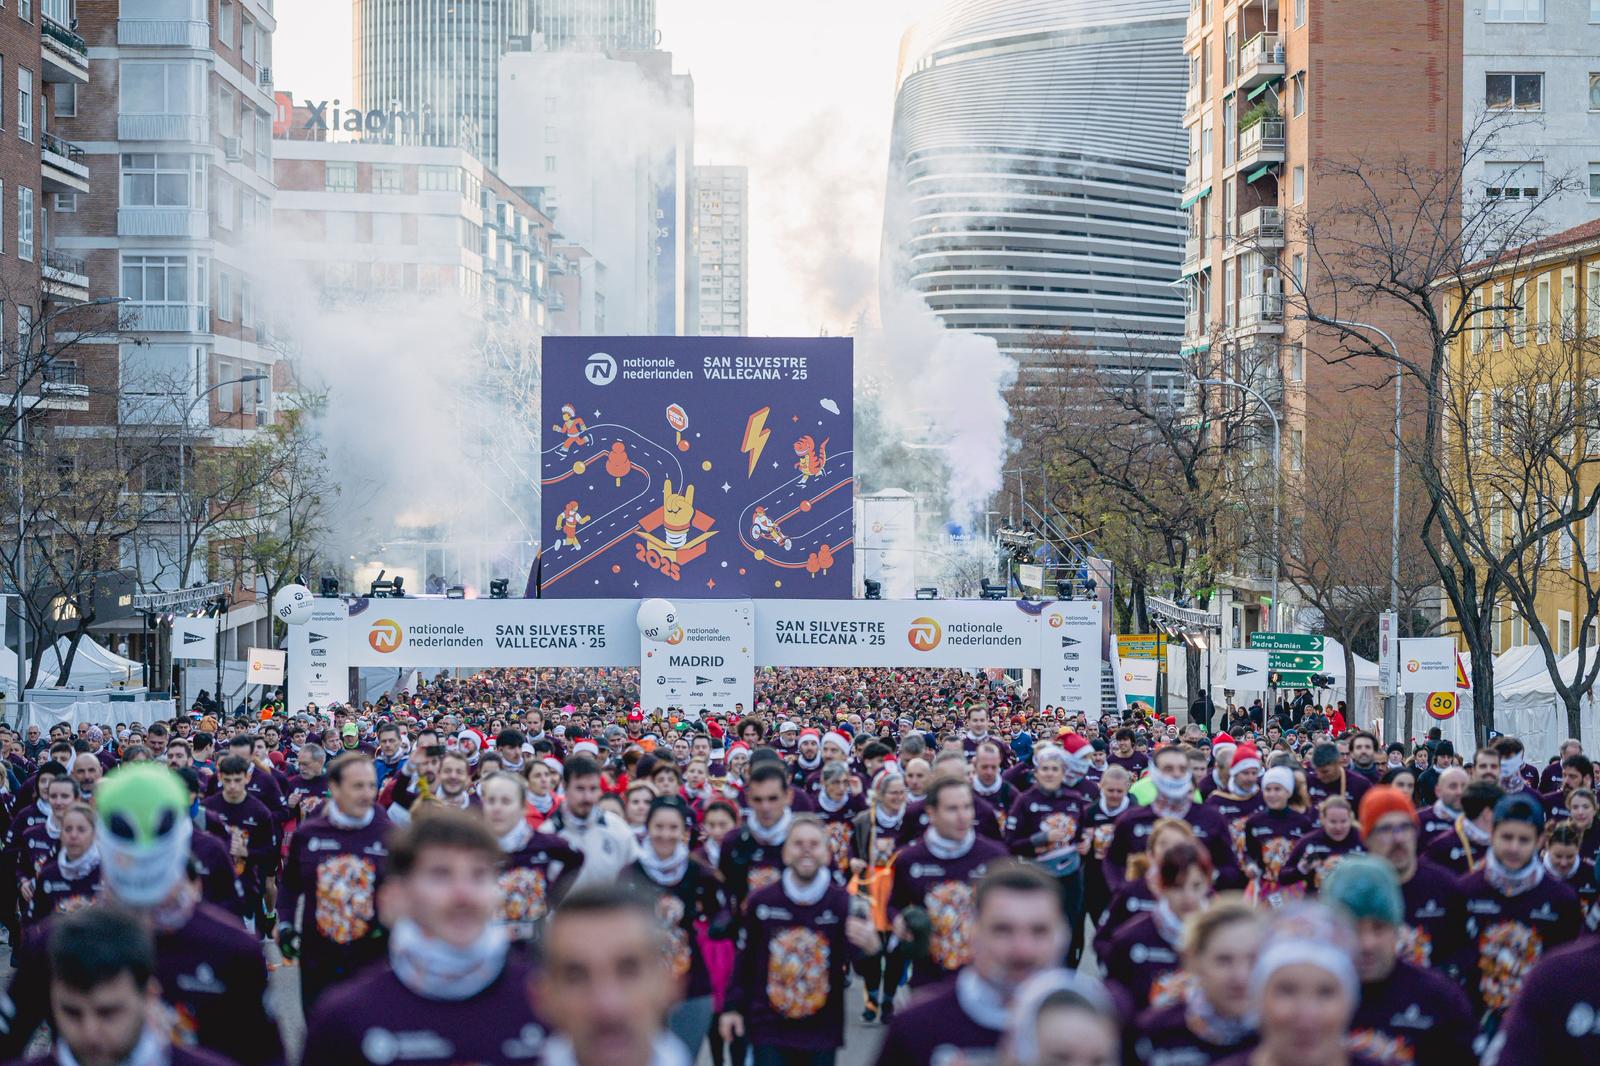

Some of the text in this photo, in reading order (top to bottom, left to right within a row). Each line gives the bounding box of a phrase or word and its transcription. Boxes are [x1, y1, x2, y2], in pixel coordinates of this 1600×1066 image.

[304, 99, 432, 135] Xiaomi
[623, 357, 675, 368] nationale
[703, 356, 807, 368] SAN SILVESTRE
[623, 369, 694, 380] nederlanden
[703, 368, 808, 380] VALLECANA 25
[635, 542, 681, 581] 2025
[279, 603, 292, 617] 60'
[409, 624, 464, 634] nationale
[495, 624, 605, 635] SAN SILVESTRE
[776, 620, 885, 632] SAN SILVESTRE
[948, 622, 1003, 633] nationale
[645, 627, 659, 638] 60'
[409, 636, 484, 647] nederlanden
[496, 637, 606, 648] VALLECANA 25
[776, 633, 886, 646] VALLECANA 25
[948, 634, 1022, 646] nederlanden
[1273, 641, 1301, 649] Damián
[669, 656, 724, 667] MADRID
[1433, 697, 1452, 709] 30
